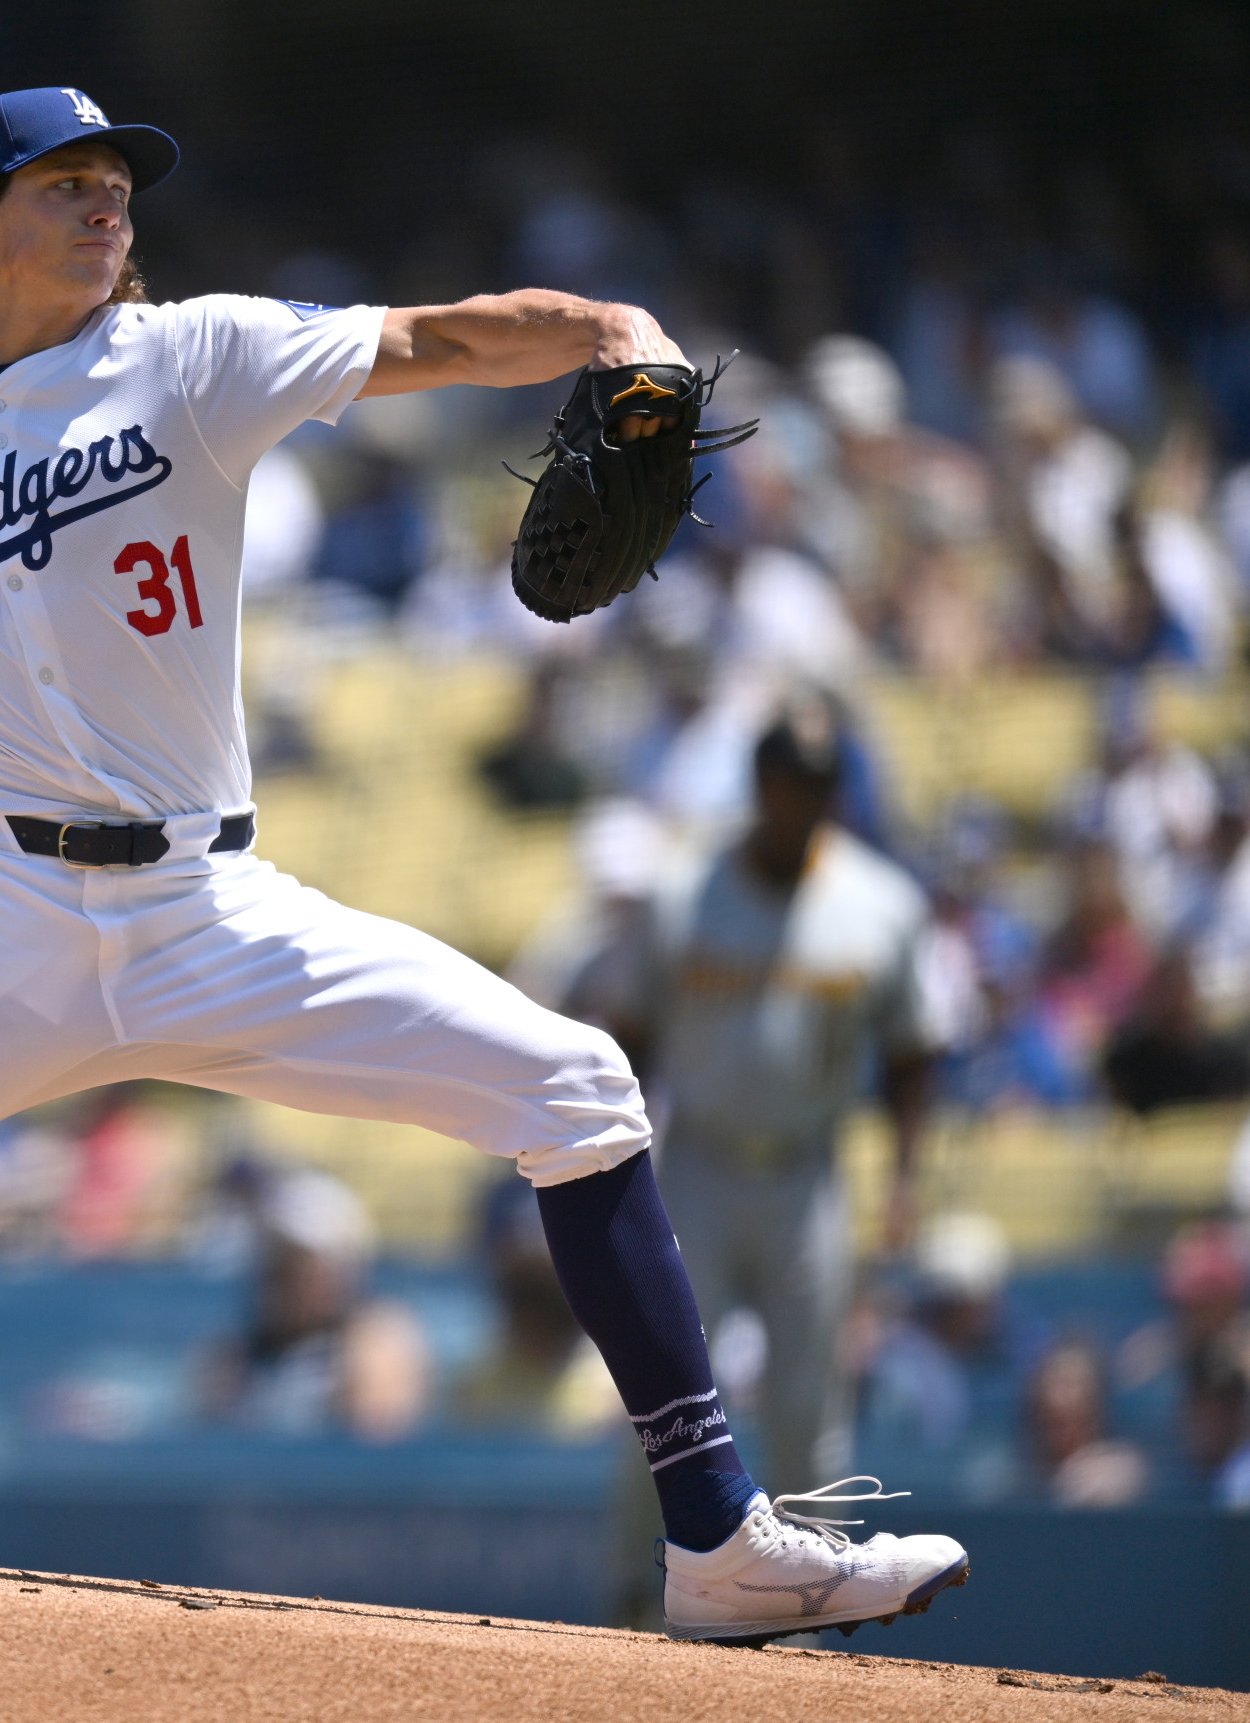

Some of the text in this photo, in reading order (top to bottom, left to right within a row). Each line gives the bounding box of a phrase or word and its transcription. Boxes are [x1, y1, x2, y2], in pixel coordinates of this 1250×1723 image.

[61, 89, 108, 128] LA
[113, 534, 204, 638] 31
[639, 1406, 727, 1453] Los Angeles
